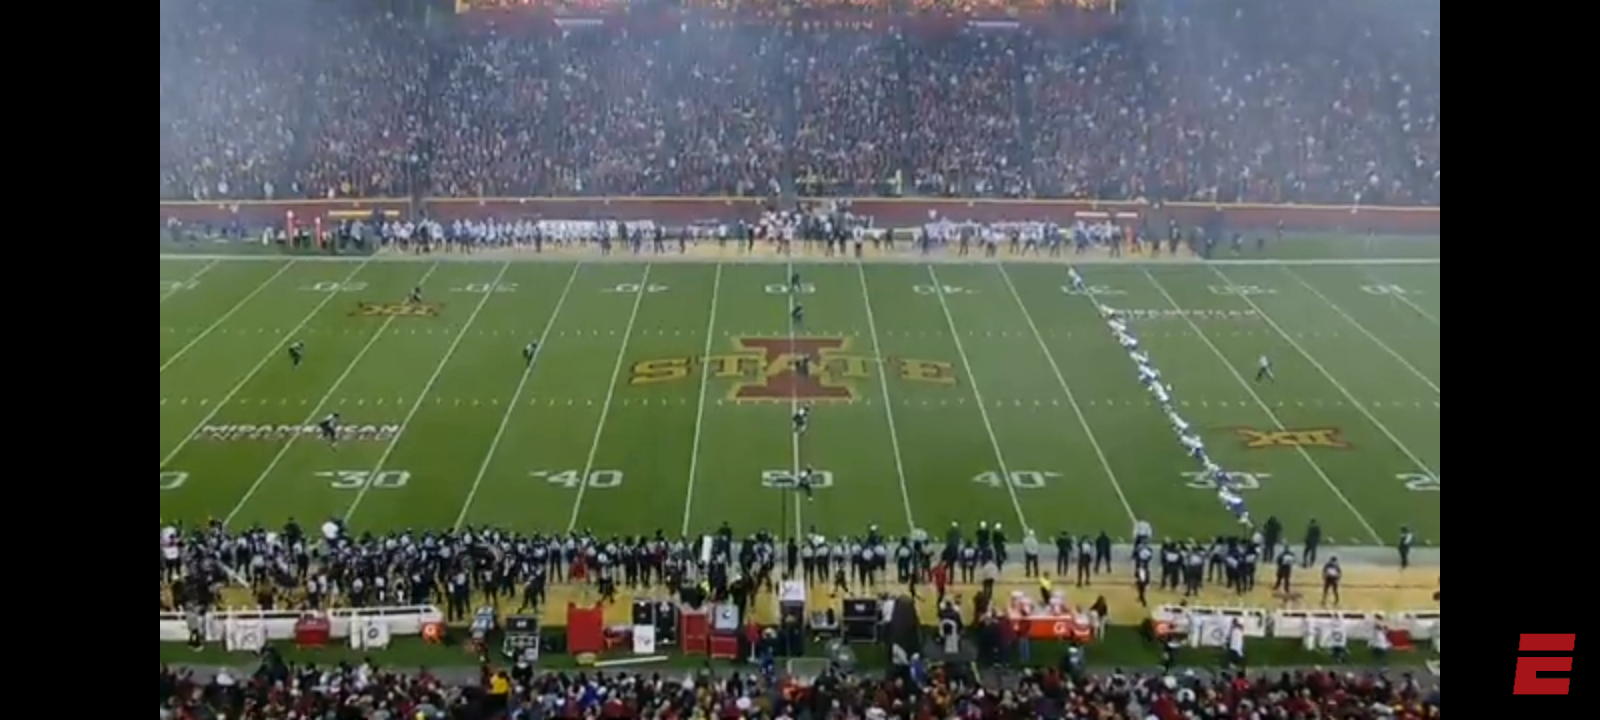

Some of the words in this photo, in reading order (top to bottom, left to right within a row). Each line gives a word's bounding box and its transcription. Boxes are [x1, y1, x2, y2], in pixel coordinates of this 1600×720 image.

[629, 353, 957, 385] STATE
[331, 470, 412, 489] 30
[546, 470, 624, 488] 40
[761, 470, 833, 489] 50
[971, 471, 1046, 489] 40
[1180, 471, 1260, 489] 30
